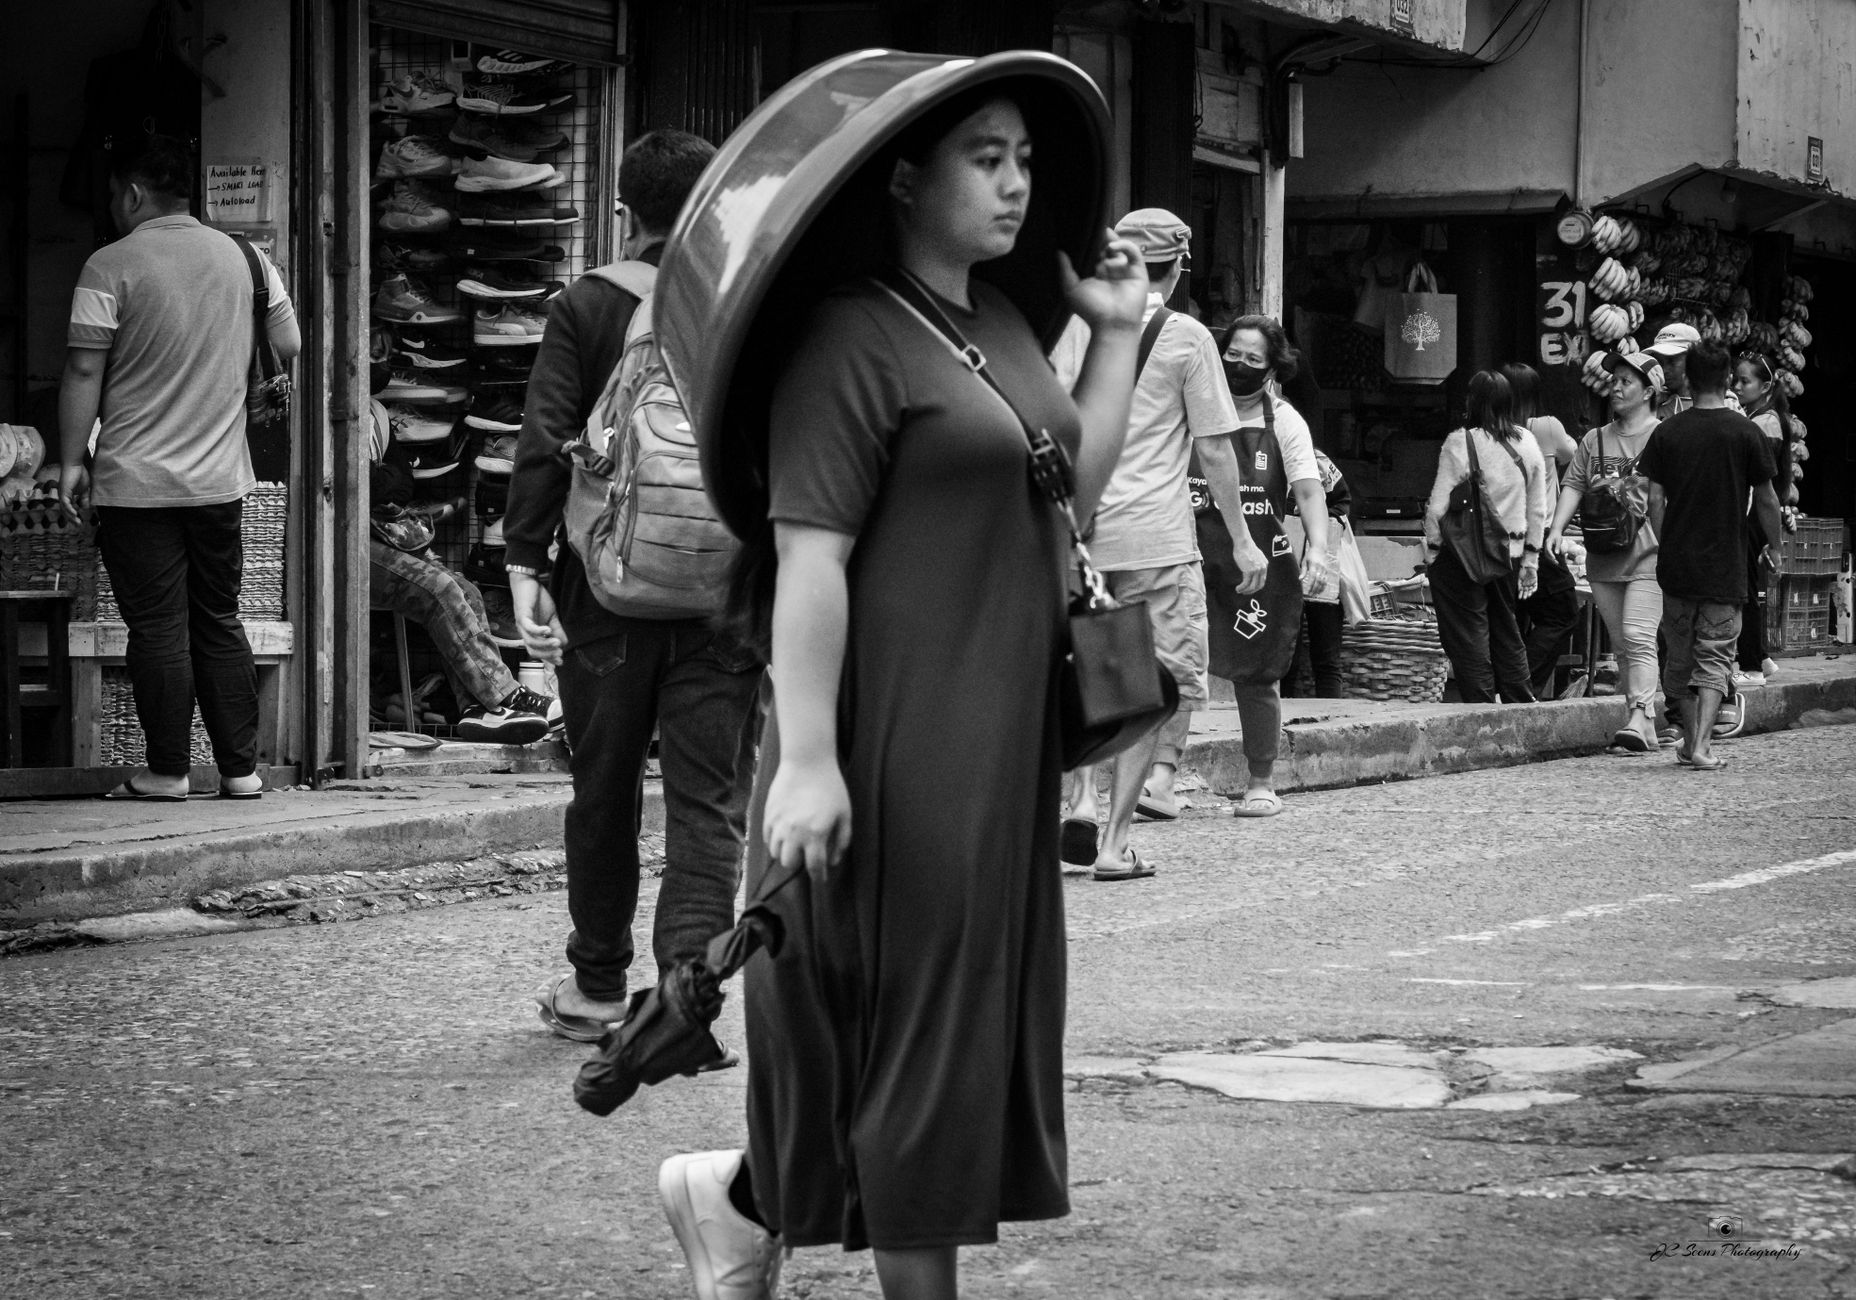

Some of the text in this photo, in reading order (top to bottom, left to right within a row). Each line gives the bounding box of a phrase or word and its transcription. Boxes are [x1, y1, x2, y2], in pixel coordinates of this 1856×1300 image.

[210, 166, 247, 178] Available
[220, 195, 256, 207] Autoload
[1540, 280, 1586, 328] 31
